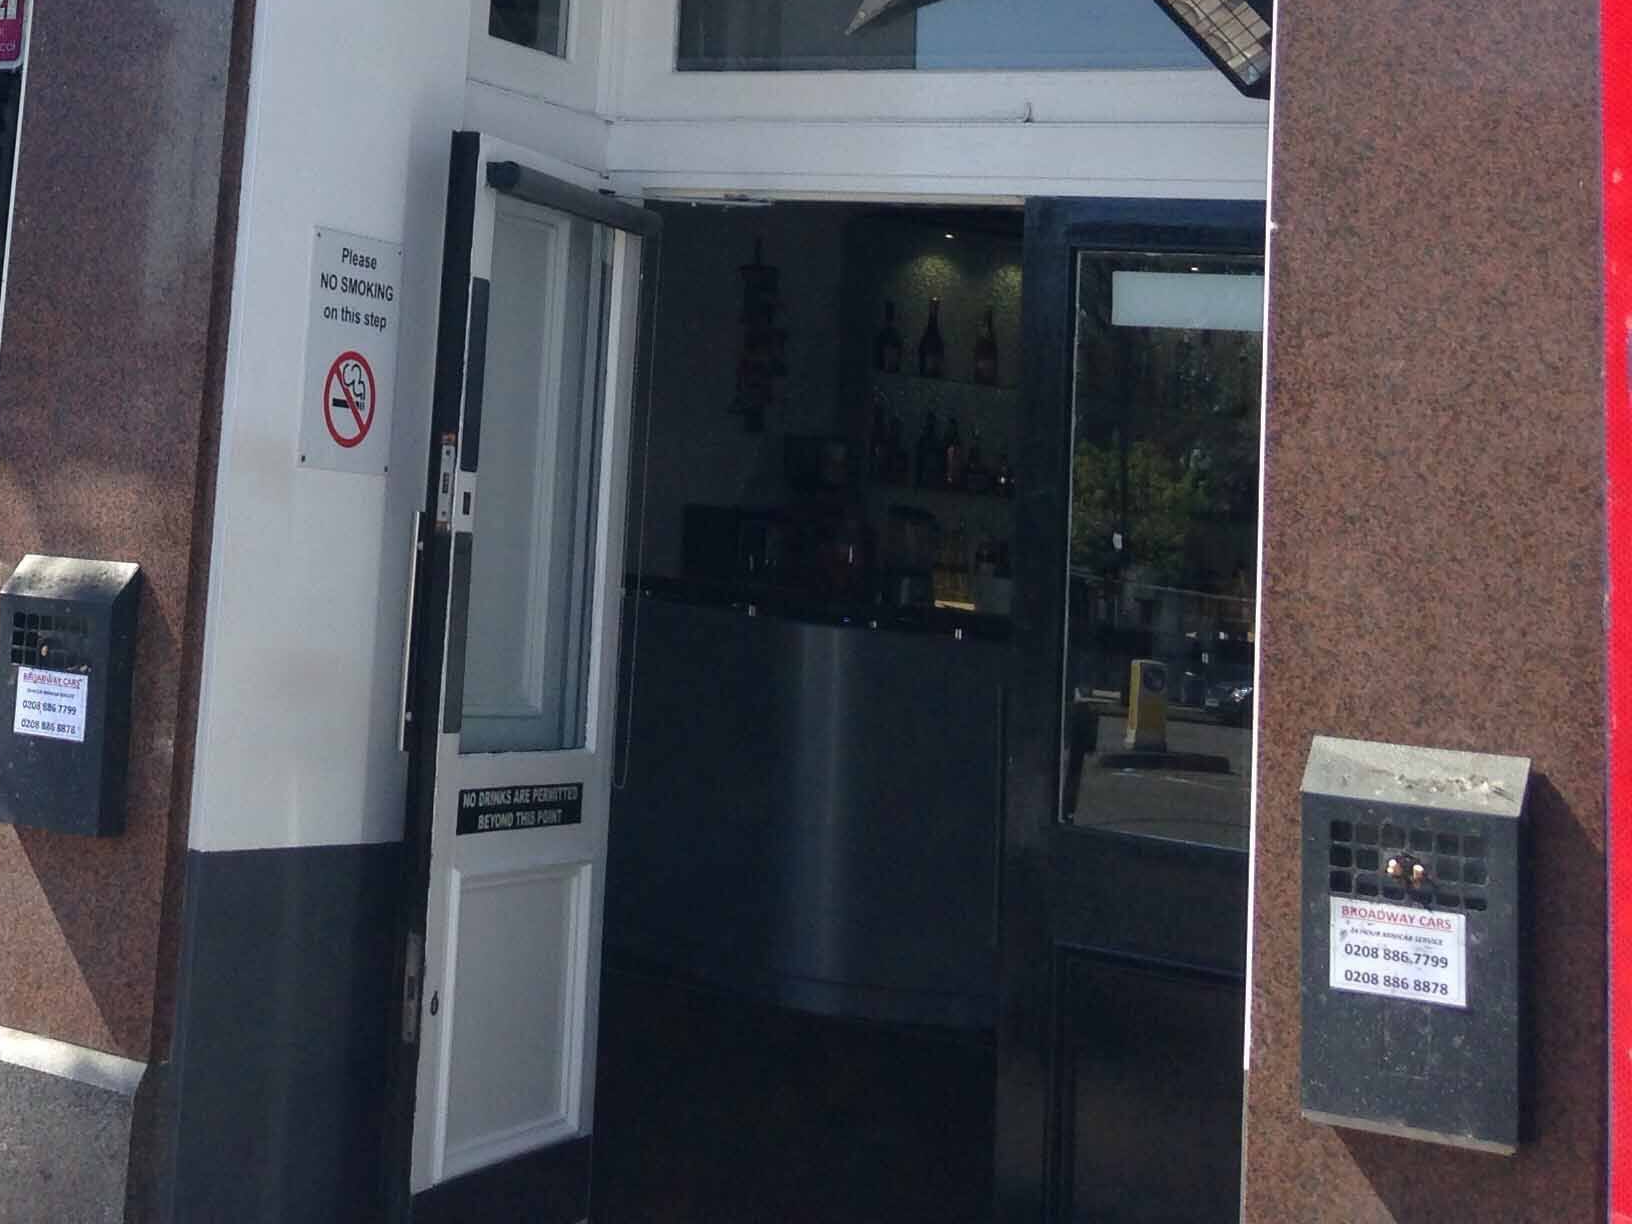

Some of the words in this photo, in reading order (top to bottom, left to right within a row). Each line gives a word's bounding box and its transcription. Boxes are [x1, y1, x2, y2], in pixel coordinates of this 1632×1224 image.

[341, 248, 377, 270] Please
[320, 272, 338, 291] NO
[340, 279, 394, 302] SMOKING
[323, 306, 338, 321] on
[341, 306, 361, 325] this
[364, 311, 387, 332] step
[58, 704, 77, 716] 7799
[462, 791, 475, 809] NO
[478, 789, 512, 807] DRINKS
[513, 787, 531, 804] ARE
[532, 785, 578, 802] PERMITTED
[477, 811, 514, 830] BEYOND
[516, 809, 536, 826] THIS
[537, 809, 563, 824] POINT
[1341, 905, 1416, 925] BROADWAY
[1419, 916, 1452, 930] CARS
[1344, 943, 1379, 960] 0208
[1344, 969, 1379, 986] 0208
[1383, 974, 1409, 990] 886
[1413, 979, 1449, 996] 8878
